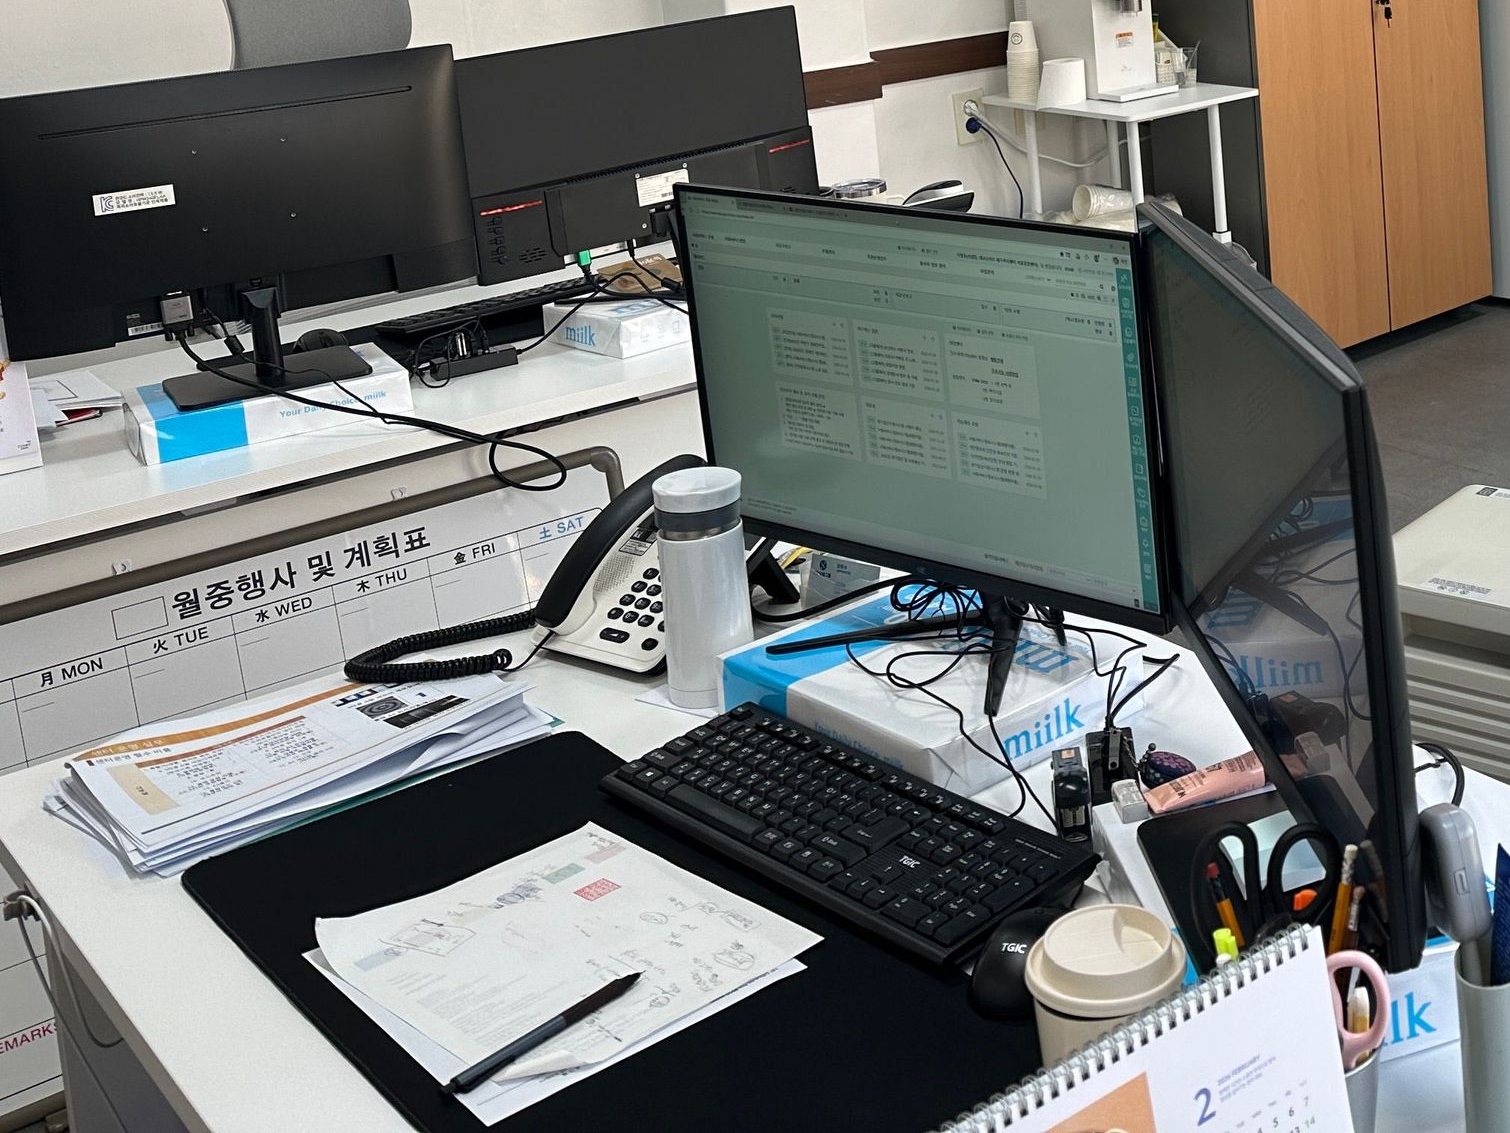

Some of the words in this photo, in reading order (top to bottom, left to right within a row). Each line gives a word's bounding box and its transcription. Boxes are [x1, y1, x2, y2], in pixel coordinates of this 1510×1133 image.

[565, 325, 596, 347] miilk
[280, 409, 301, 418] Your
[364, 390, 387, 402] miilk
[172, 562, 298, 621] 월중행사
[307, 551, 336, 582] 및
[343, 526, 431, 572] 계획표
[40, 670, 54, 688] 月
[61, 657, 104, 682] MON
[152, 638, 168, 654] 火
[174, 626, 209, 647] TUE
[255, 608, 270, 623] 水
[274, 596, 313, 618] WED
[356, 578, 371, 593] 木
[374, 566, 408, 588] THU
[453, 550, 467, 566] 金
[472, 542, 497, 560] FRI
[539, 526, 553, 541] 土
[556, 515, 585, 536] SAT
[1004, 697, 1085, 761] miilk
[899, 855, 920, 868] TGIC
[1001, 942, 1028, 955] TGIC
[1193, 1087, 1216, 1127] 2
